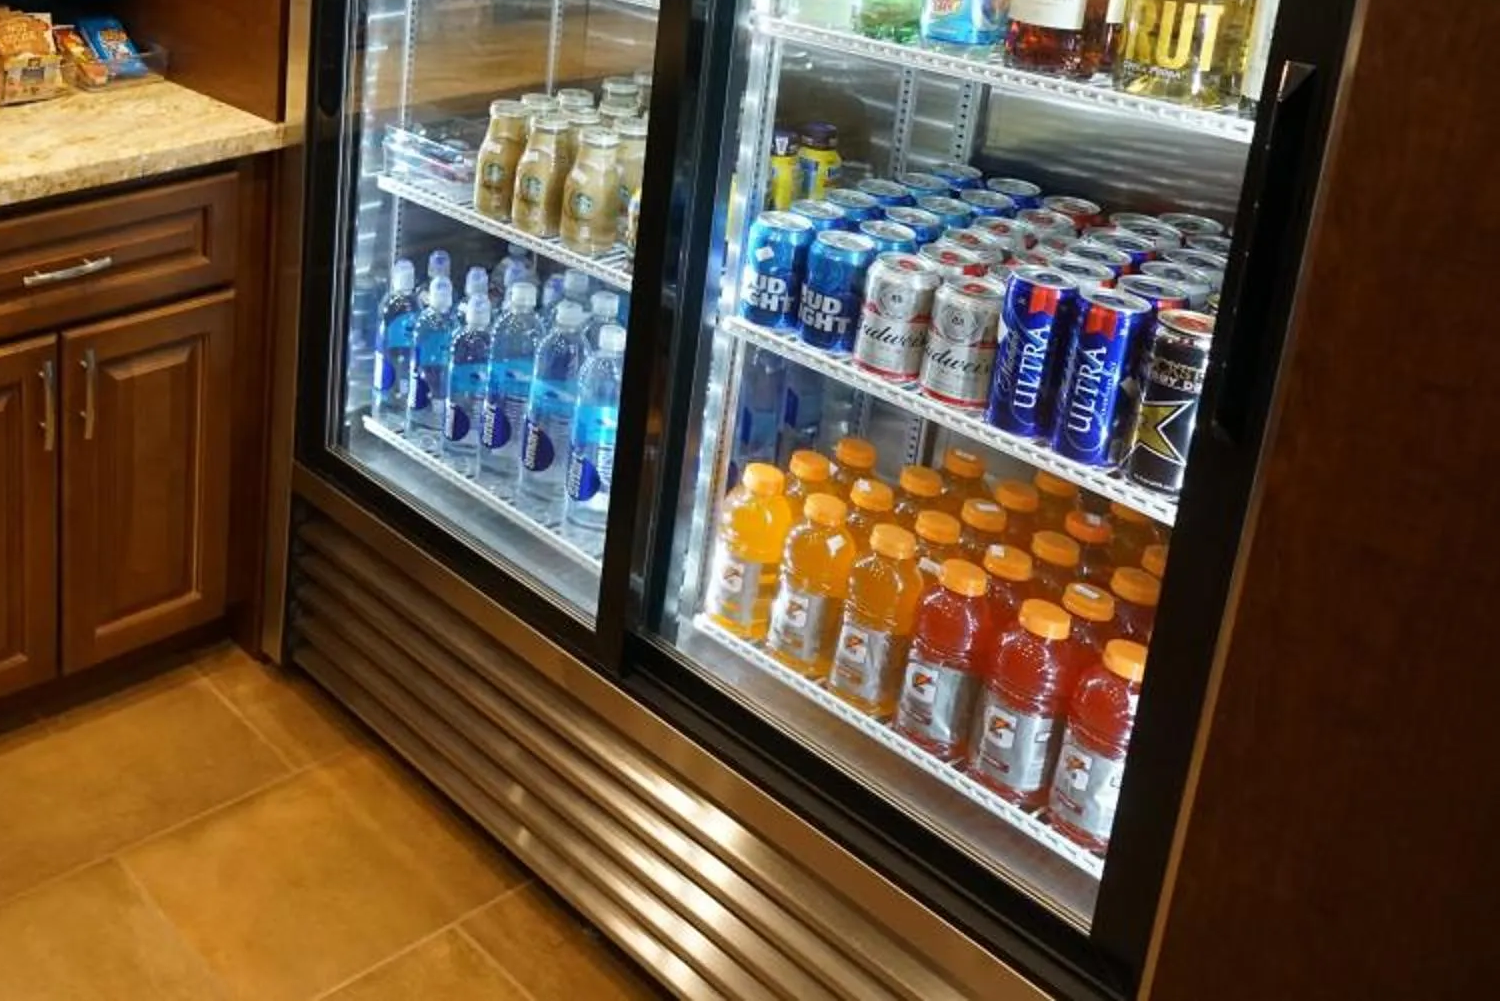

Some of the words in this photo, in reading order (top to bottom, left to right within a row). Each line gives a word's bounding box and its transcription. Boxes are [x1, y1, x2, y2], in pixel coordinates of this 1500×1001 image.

[751, 294, 795, 313] GHT
[799, 307, 851, 334] GHT
[1013, 324, 1051, 409] ULTRA
[1067, 346, 1108, 434] ULTRA
